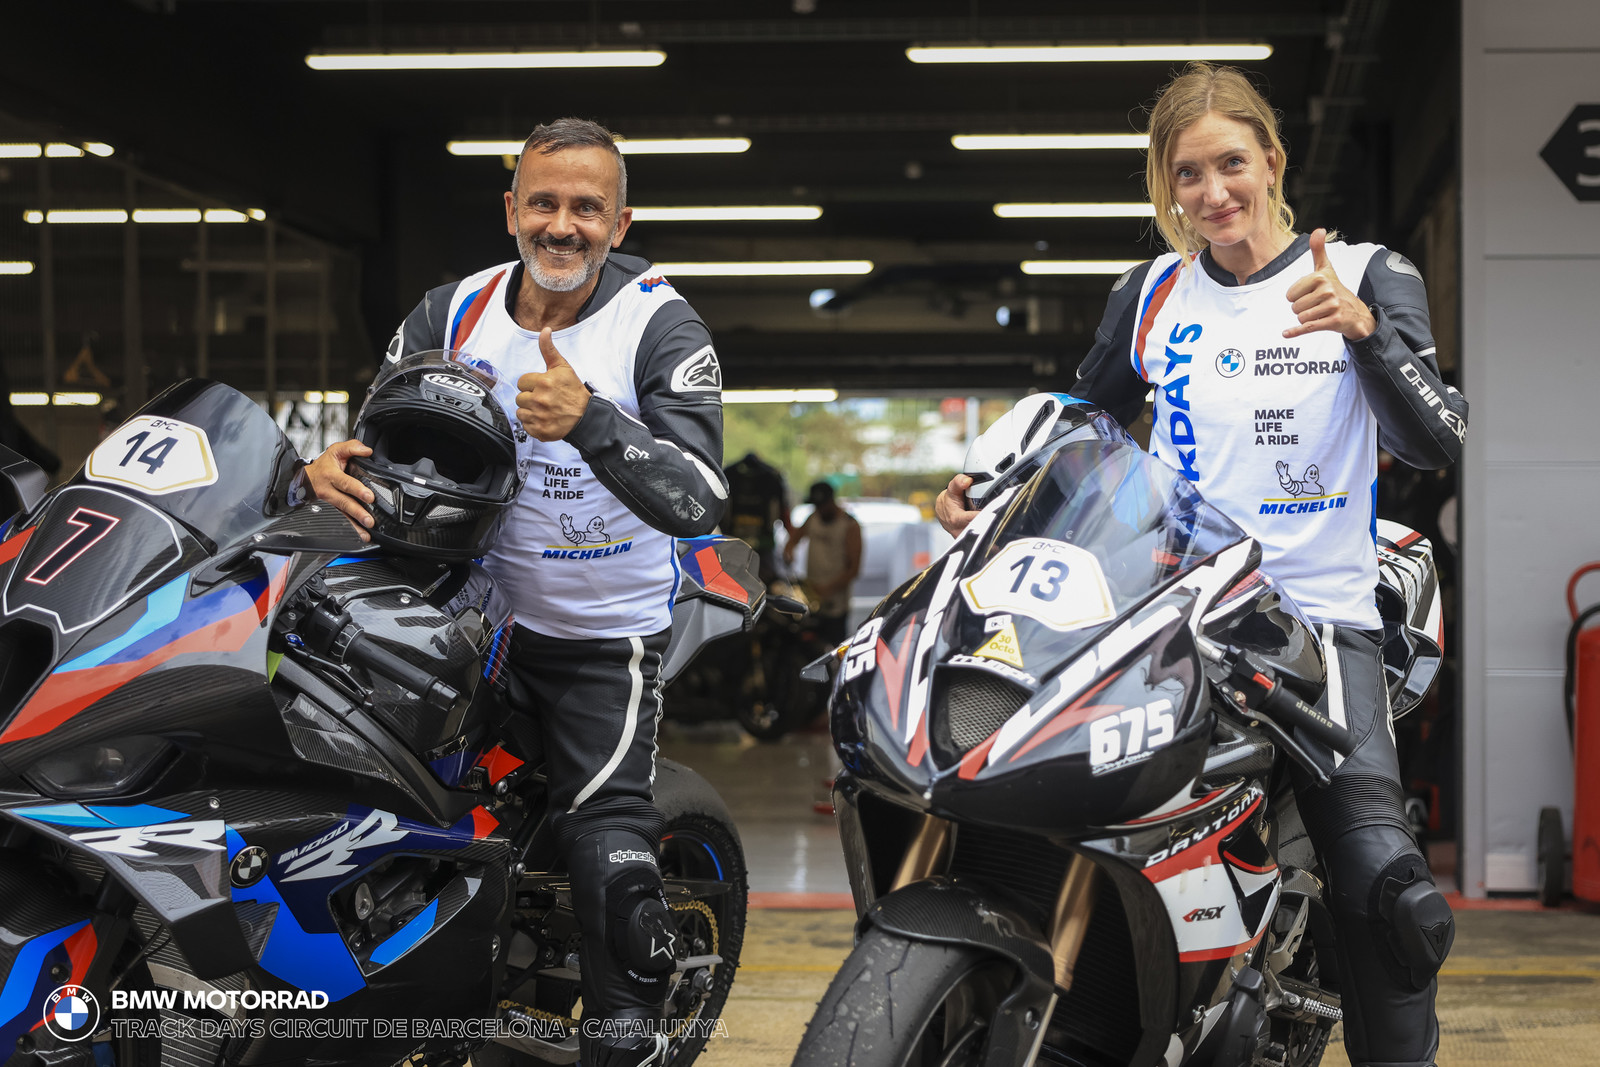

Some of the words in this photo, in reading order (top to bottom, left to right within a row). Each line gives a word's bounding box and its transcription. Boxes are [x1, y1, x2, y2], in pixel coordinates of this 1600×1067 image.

[1255, 347, 1300, 361] BMW
[1254, 360, 1347, 376] MOTORRAD
[428, 374, 482, 394] HJC
[1163, 322, 1203, 489] KDAYS
[1399, 362, 1467, 444] DAINESE
[1254, 409, 1295, 420] MAKE
[1254, 422, 1283, 433] LIFE
[1255, 435, 1265, 445] A
[1268, 434, 1299, 445] RIDE
[119, 430, 179, 475] 14
[544, 465, 581, 477] MAKE
[543, 476, 569, 489] LIFE
[542, 489, 551, 499] A
[554, 490, 584, 500] RIDE
[1259, 497, 1347, 515] MICHELIN
[25, 507, 120, 585] 7
[541, 541, 633, 560] MICHELIN
[1009, 555, 1070, 602] 13
[998, 634, 1012, 644] 30
[989, 641, 1015, 655] Octo
[1295, 700, 1333, 728] domino
[1090, 698, 1174, 767] 675
[1144, 786, 1264, 868] DAYTONA
[236, 848, 268, 863] BMW
